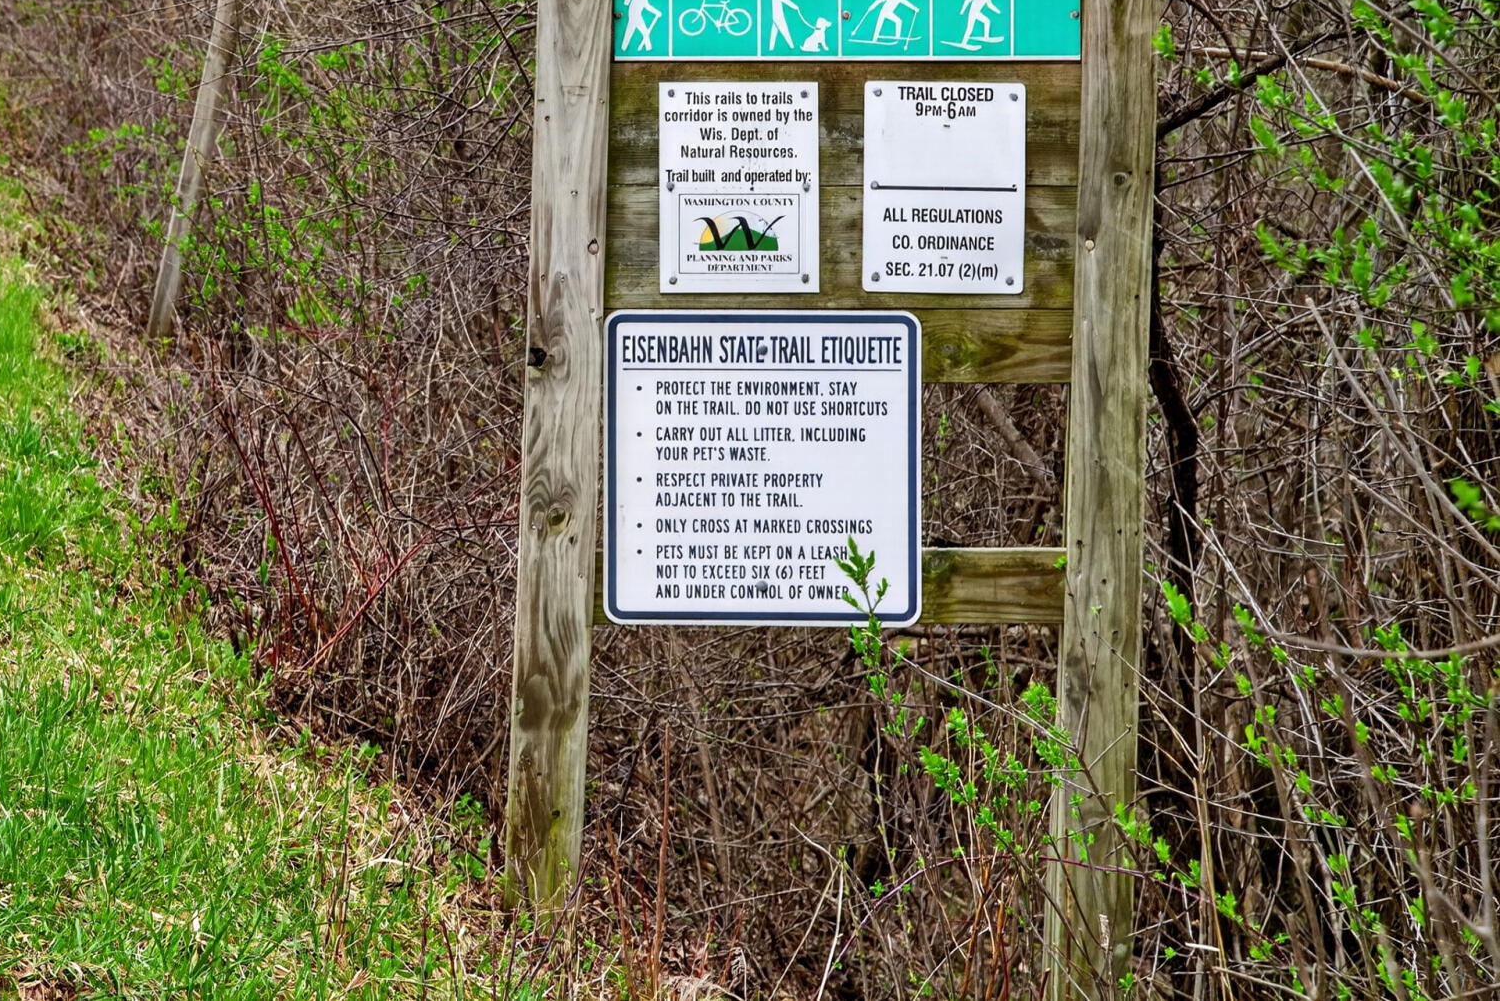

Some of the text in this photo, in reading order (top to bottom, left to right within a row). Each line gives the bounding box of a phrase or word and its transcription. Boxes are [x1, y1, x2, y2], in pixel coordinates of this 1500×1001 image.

[685, 92, 792, 104] This rails to trails
[898, 87, 993, 102] TRAIL CLOSED
[665, 109, 812, 125] corridor is owned by the
[700, 128, 778, 143] Wis. Dept. of
[681, 145, 797, 158] Natural Resources.
[666, 169, 811, 185] Trail built and operated by:
[753, 198, 793, 206] COUNTY
[883, 208, 1002, 224] ALL REGULATIONS
[893, 235, 994, 250] CO. ORDINANCE
[708, 264, 773, 272] DEPARTMENT
[886, 262, 998, 280] SEC. 21.07 (2)(m)
[623, 336, 901, 365] EISENBAHN STATE TRAIL ETIQUETTE
[657, 381, 705, 395] PROTECT
[711, 381, 731, 395] THE
[829, 382, 857, 395] STAY
[656, 401, 887, 416] ON THE TRAIL. DO NOT USE SHORTCUTS
[657, 427, 694, 441] CARRY
[700, 427, 722, 441] OUT
[727, 428, 748, 441] ALL
[801, 428, 865, 442] INCLUDING
[656, 447, 770, 461] YOUR PET'S WASTE.
[657, 473, 823, 487] RESPECT PRIVATE PROPERTY
[656, 493, 802, 507] ADJACENT TO THE TRAIL.
[656, 519, 872, 534] ONLY CROSS AT MARKED CROSSINGS
[657, 545, 848, 559] PETS MUST BE KEPT ON A LEASH
[657, 565, 825, 579] NOT TO EXCEED SIX (6) FEET
[656, 584, 679, 598] AND
[686, 585, 725, 598] UNDER
[789, 585, 803, 599] OF
